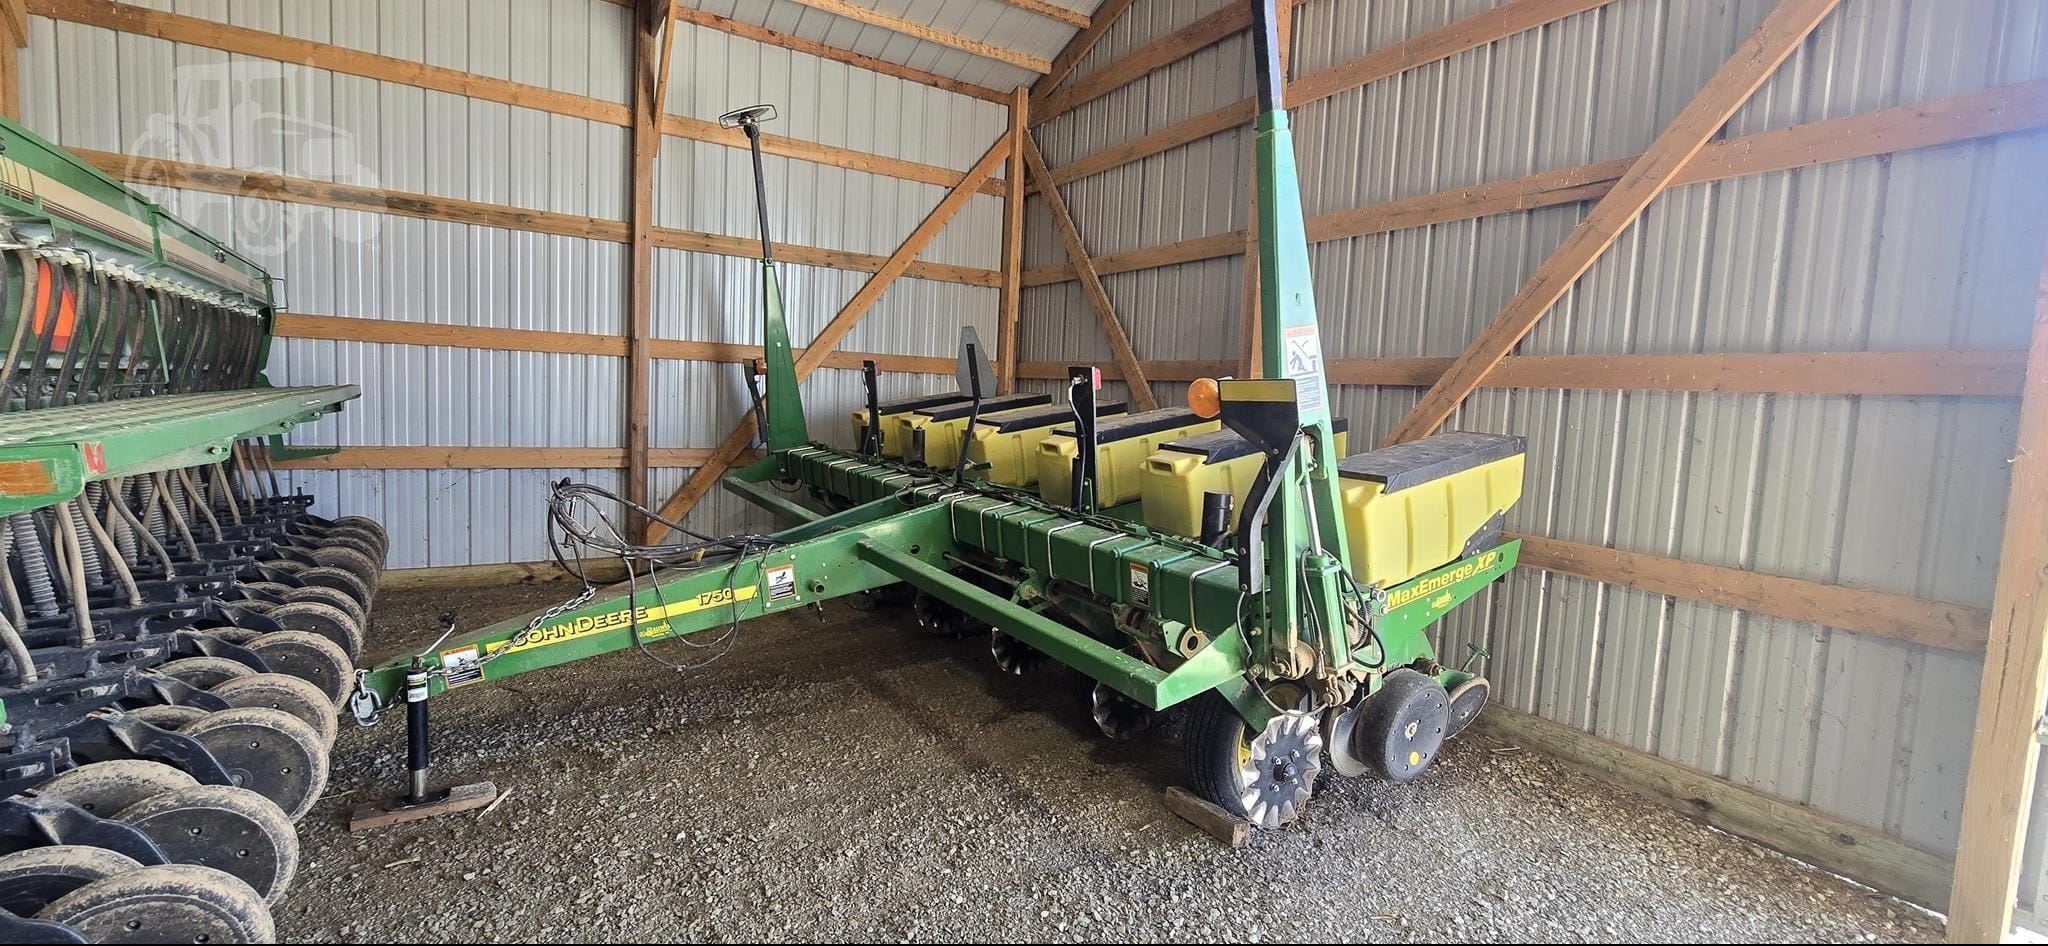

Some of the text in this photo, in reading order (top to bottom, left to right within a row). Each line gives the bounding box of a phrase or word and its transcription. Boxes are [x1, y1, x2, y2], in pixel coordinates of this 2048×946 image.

[1387, 563, 1474, 608] MaxEmerge
[1472, 551, 1497, 576] XP
[696, 587, 734, 606] 1750
[576, 606, 648, 633] DEERE
